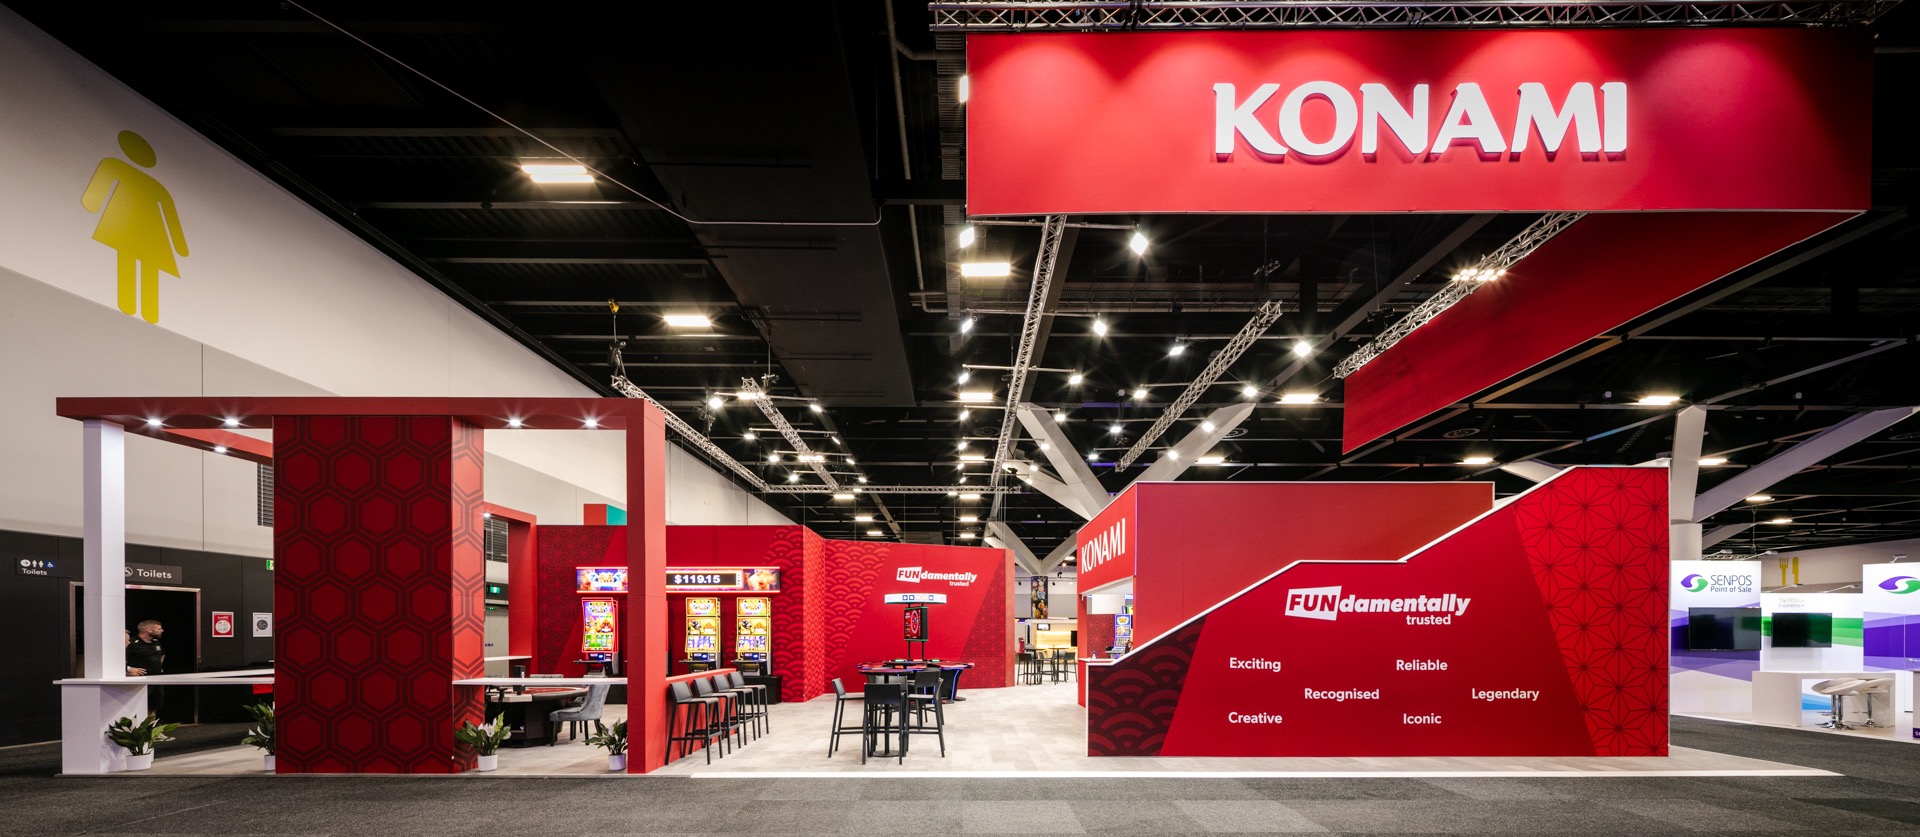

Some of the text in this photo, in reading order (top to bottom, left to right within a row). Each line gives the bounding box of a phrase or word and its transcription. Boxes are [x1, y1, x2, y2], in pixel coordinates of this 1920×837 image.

[1212, 80, 1628, 156] KONAMI
[1081, 517, 1126, 574] KONAMI
[22, 567, 47, 576] Toilets
[136, 568, 172, 579] Toilets
[898, 569, 977, 583] FUNdamentally
[674, 574, 721, 585] $119.15
[1710, 574, 1752, 586] SENPOS
[1288, 593, 1471, 616] FUNdamentally
[1406, 614, 1451, 625] trusted
[1229, 657, 1281, 672] Exciting
[1396, 659, 1448, 671] Reliable
[1304, 688, 1380, 702] Recognised
[1471, 688, 1540, 702] Legendary
[1228, 711, 1283, 724] Creative
[1403, 713, 1442, 725] Iconic
